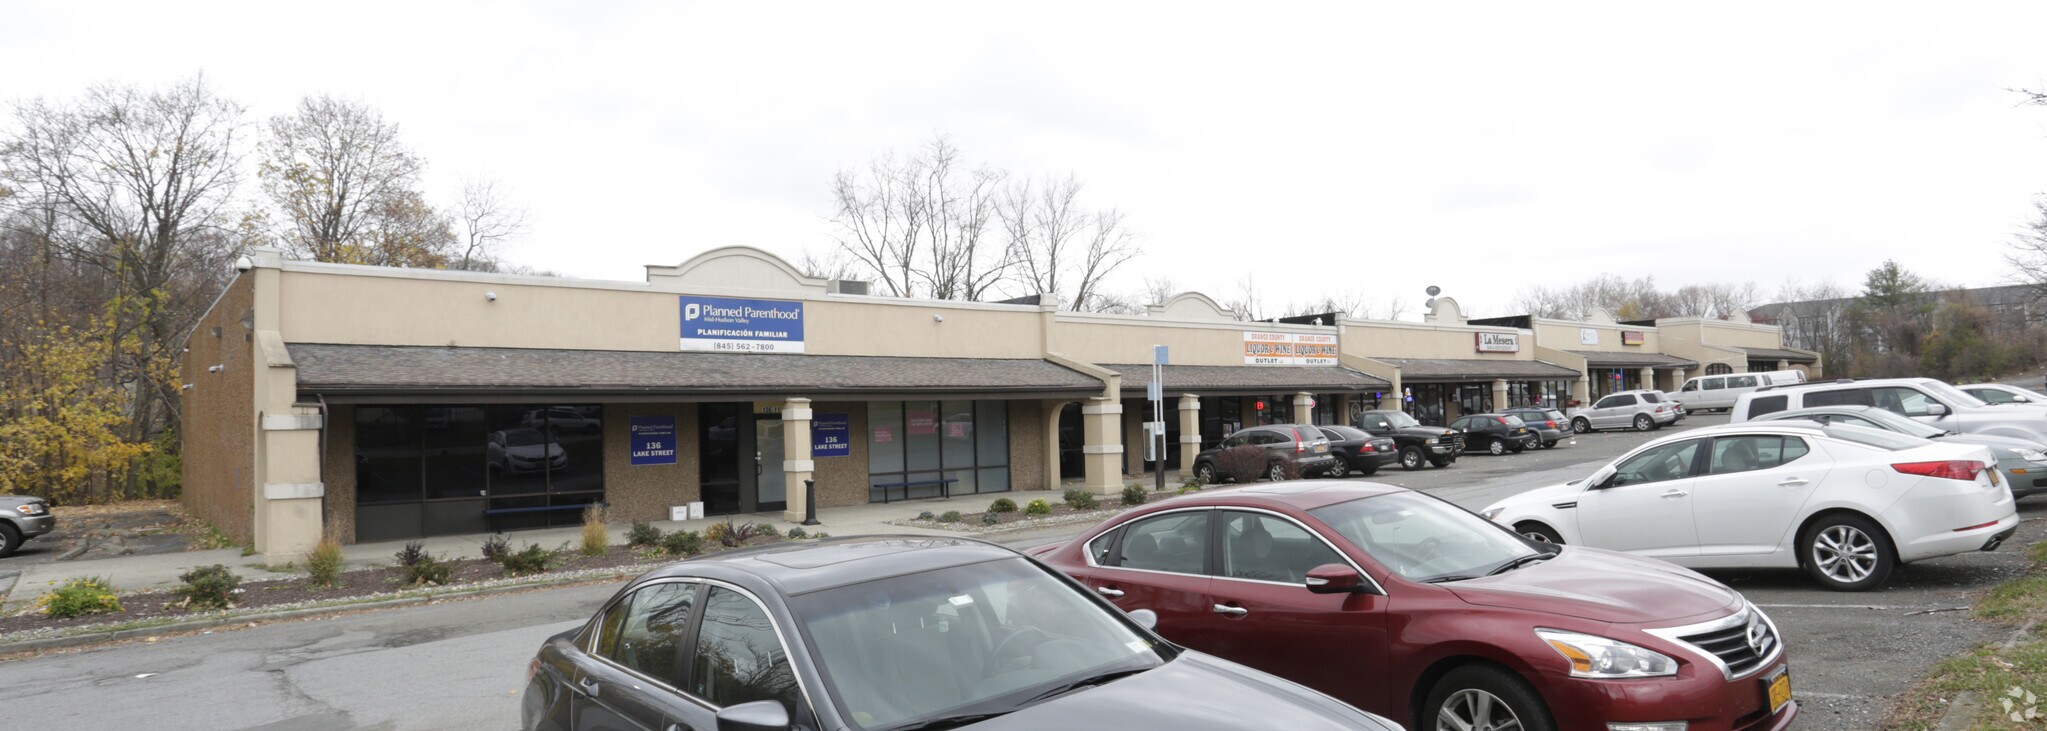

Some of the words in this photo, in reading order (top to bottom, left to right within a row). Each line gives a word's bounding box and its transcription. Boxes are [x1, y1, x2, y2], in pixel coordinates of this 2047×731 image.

[703, 304, 742, 317] Planned
[745, 306, 798, 320] Parenthood
[698, 328, 753, 337] PLANIFICACIÓN
[755, 330, 788, 338] FAMILIAR
[1484, 334, 1492, 344] La
[1492, 335, 1514, 345] Mesera
[714, 342, 734, 350] (845)
[1247, 344, 1268, 354] LIQUOR
[1275, 345, 1290, 353] WINE
[1296, 345, 1315, 355] LIQUOR
[1321, 346, 1336, 354] WINE
